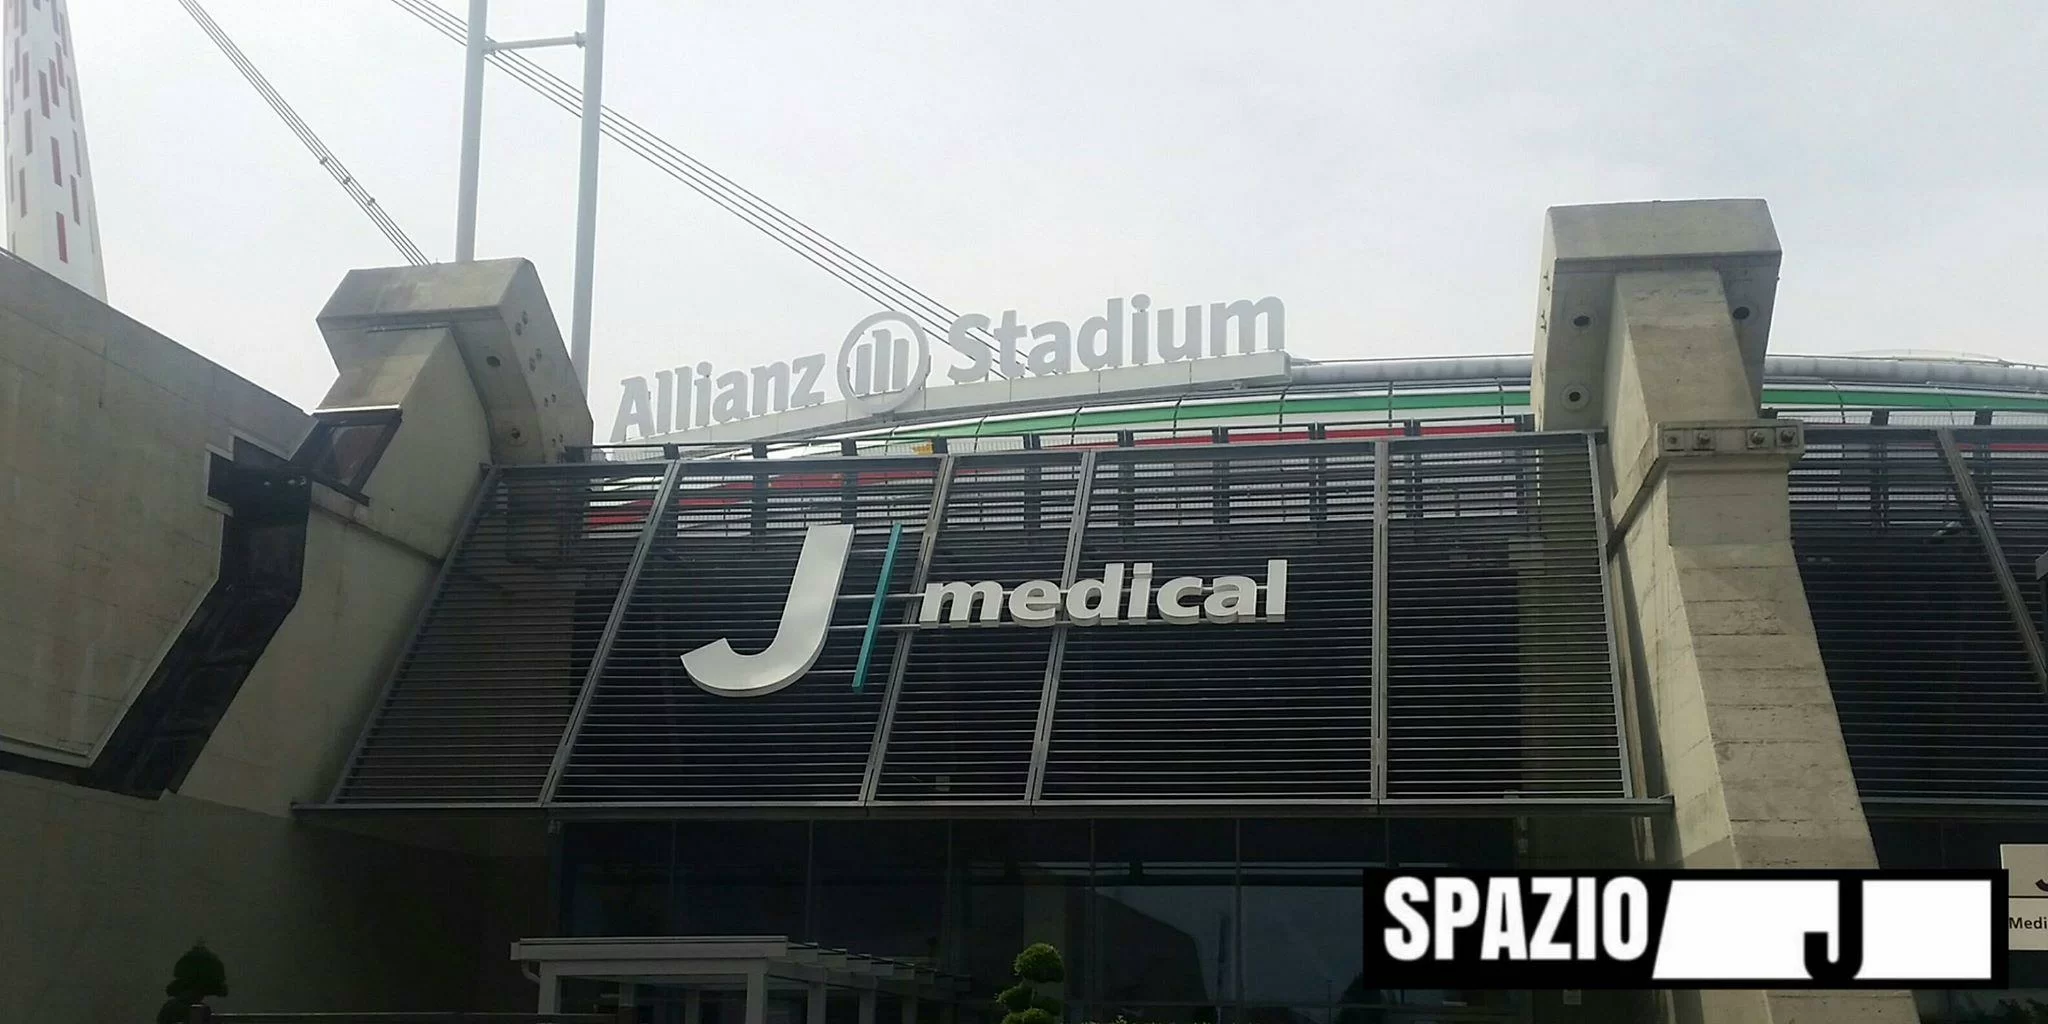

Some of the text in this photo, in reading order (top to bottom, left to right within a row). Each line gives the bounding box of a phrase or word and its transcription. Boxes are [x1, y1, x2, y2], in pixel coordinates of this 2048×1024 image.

[610, 293, 1286, 443] Allianz Stadium
[680, 523, 1289, 698] J medical
